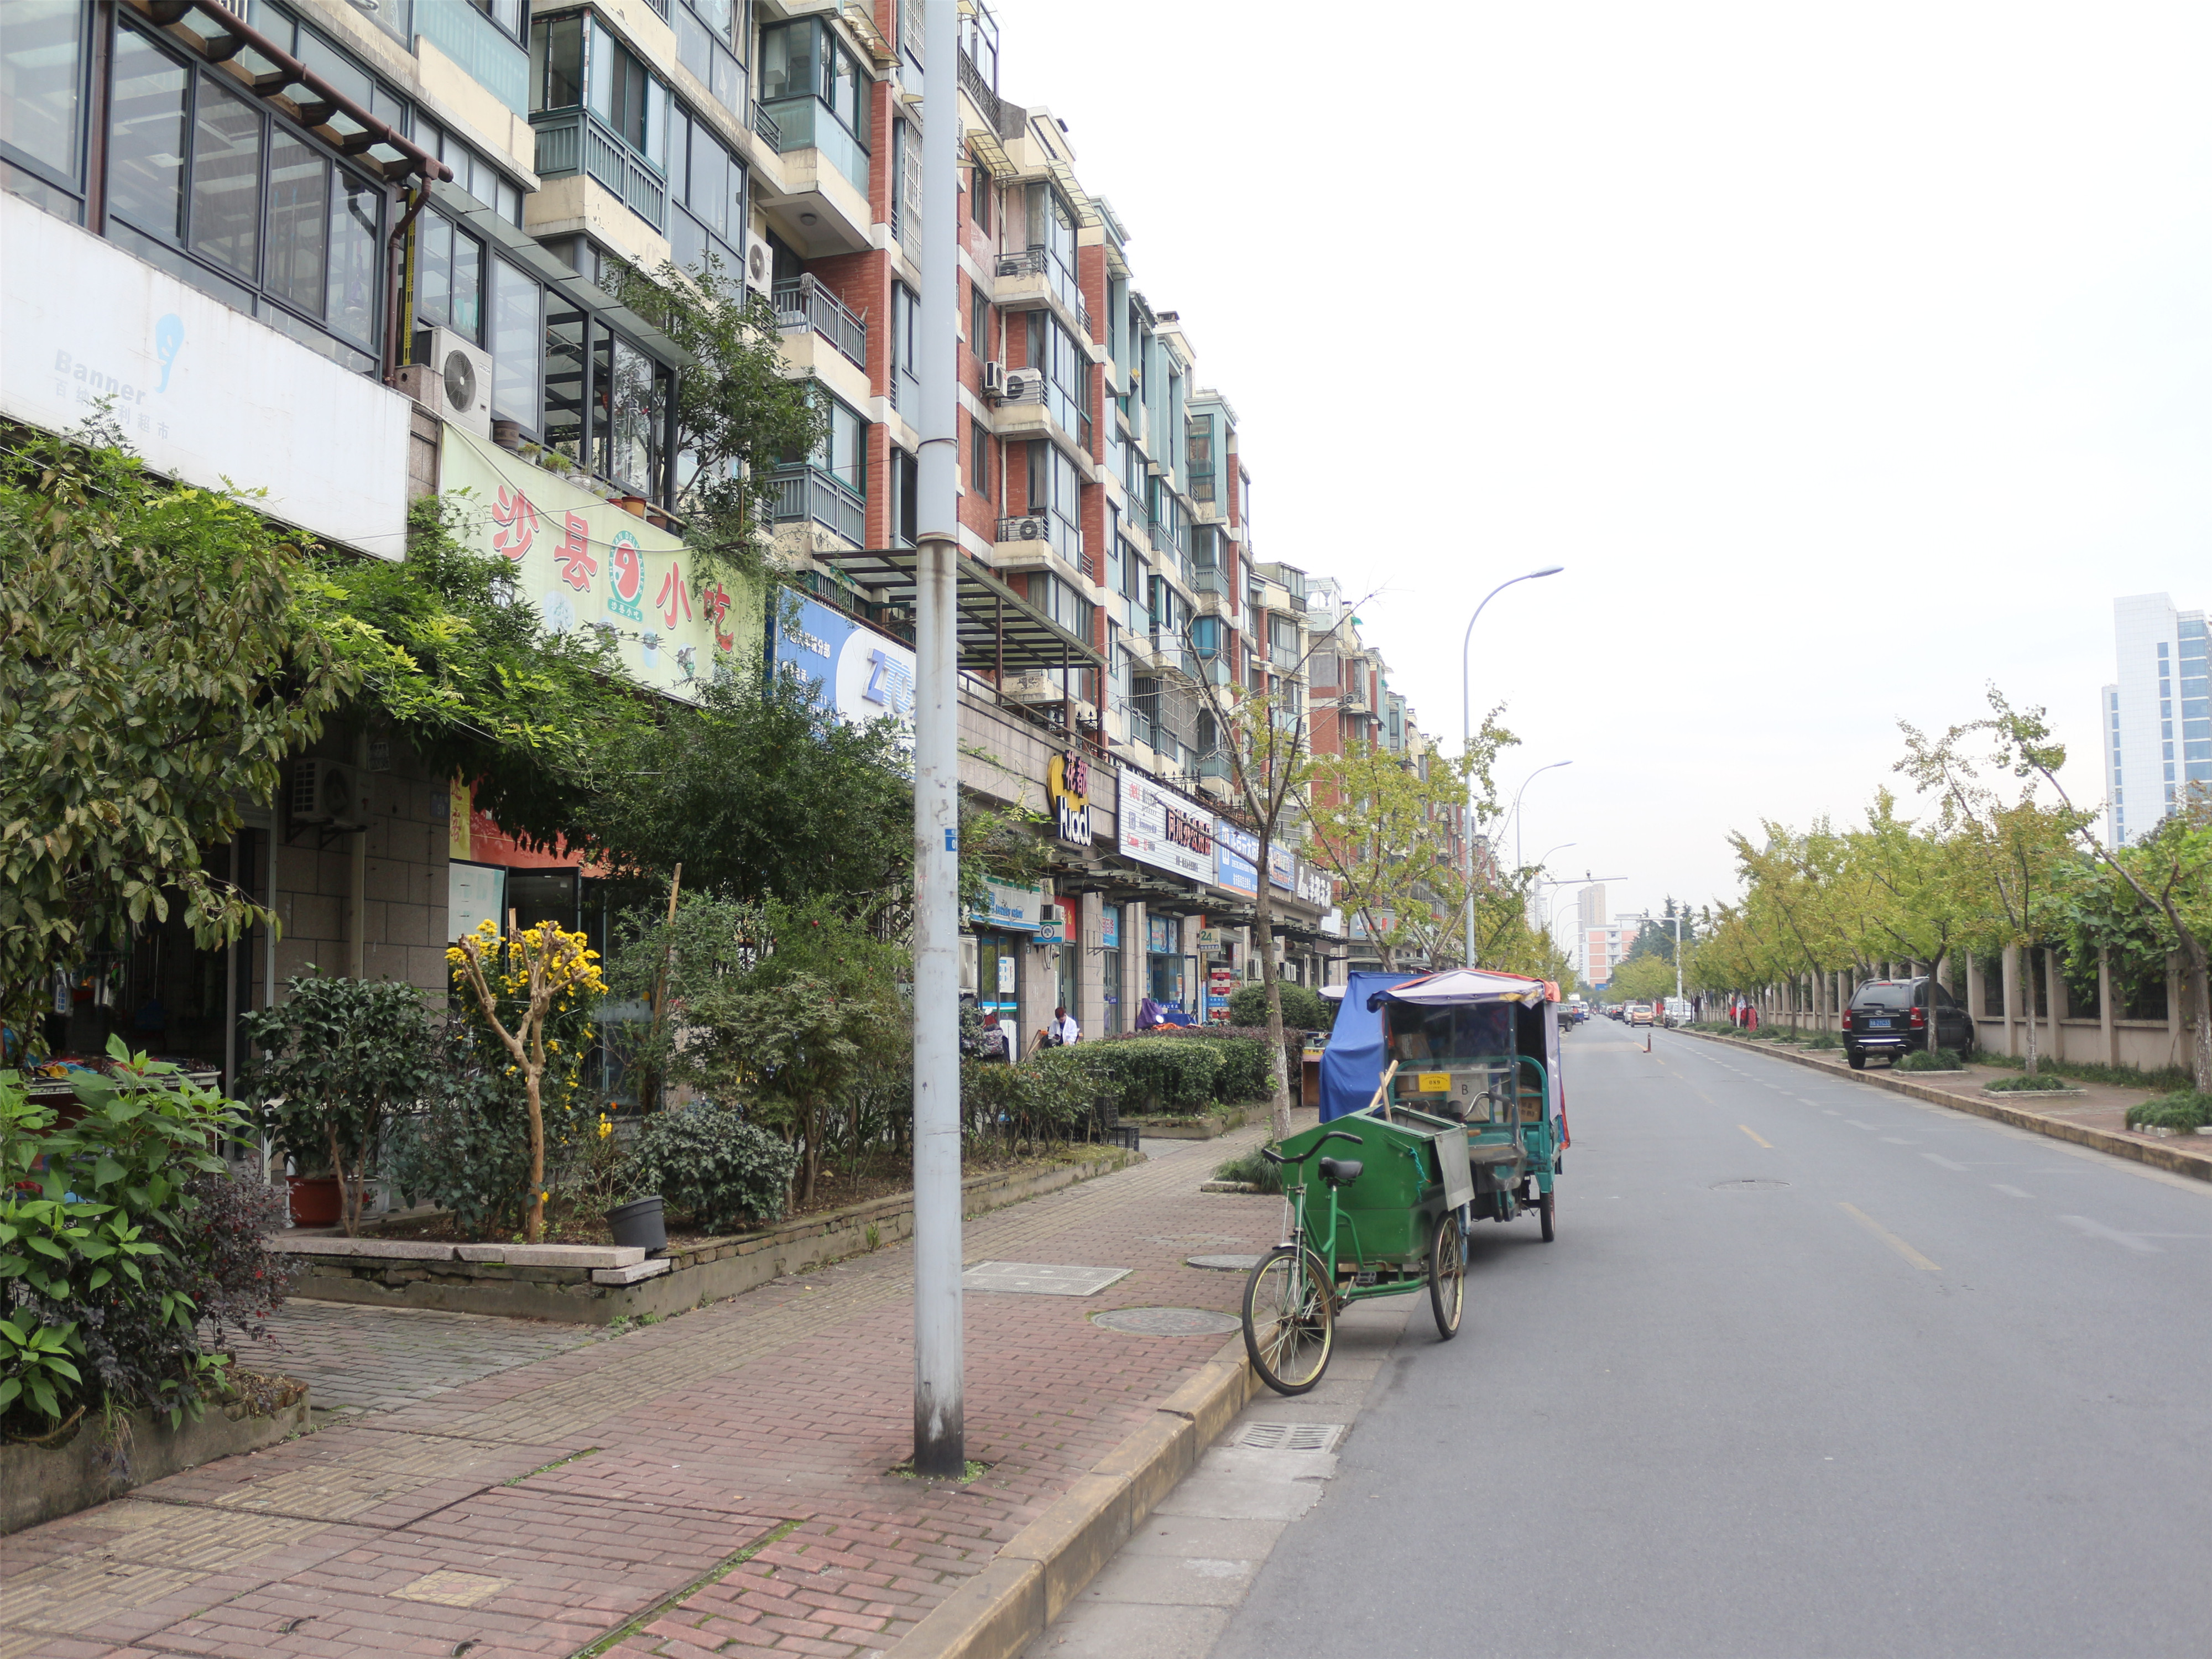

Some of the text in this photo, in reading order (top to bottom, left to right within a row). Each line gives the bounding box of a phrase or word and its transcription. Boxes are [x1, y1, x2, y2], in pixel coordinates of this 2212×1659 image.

[54, 348, 147, 405] Banner
[54, 377, 170, 440] 百纳利超市
[611, 601, 640, 621] 沙县小吃
[1063, 749, 1088, 799] 花都
[1201, 931, 1212, 943] 24
[1462, 1084, 1468, 1095] B
